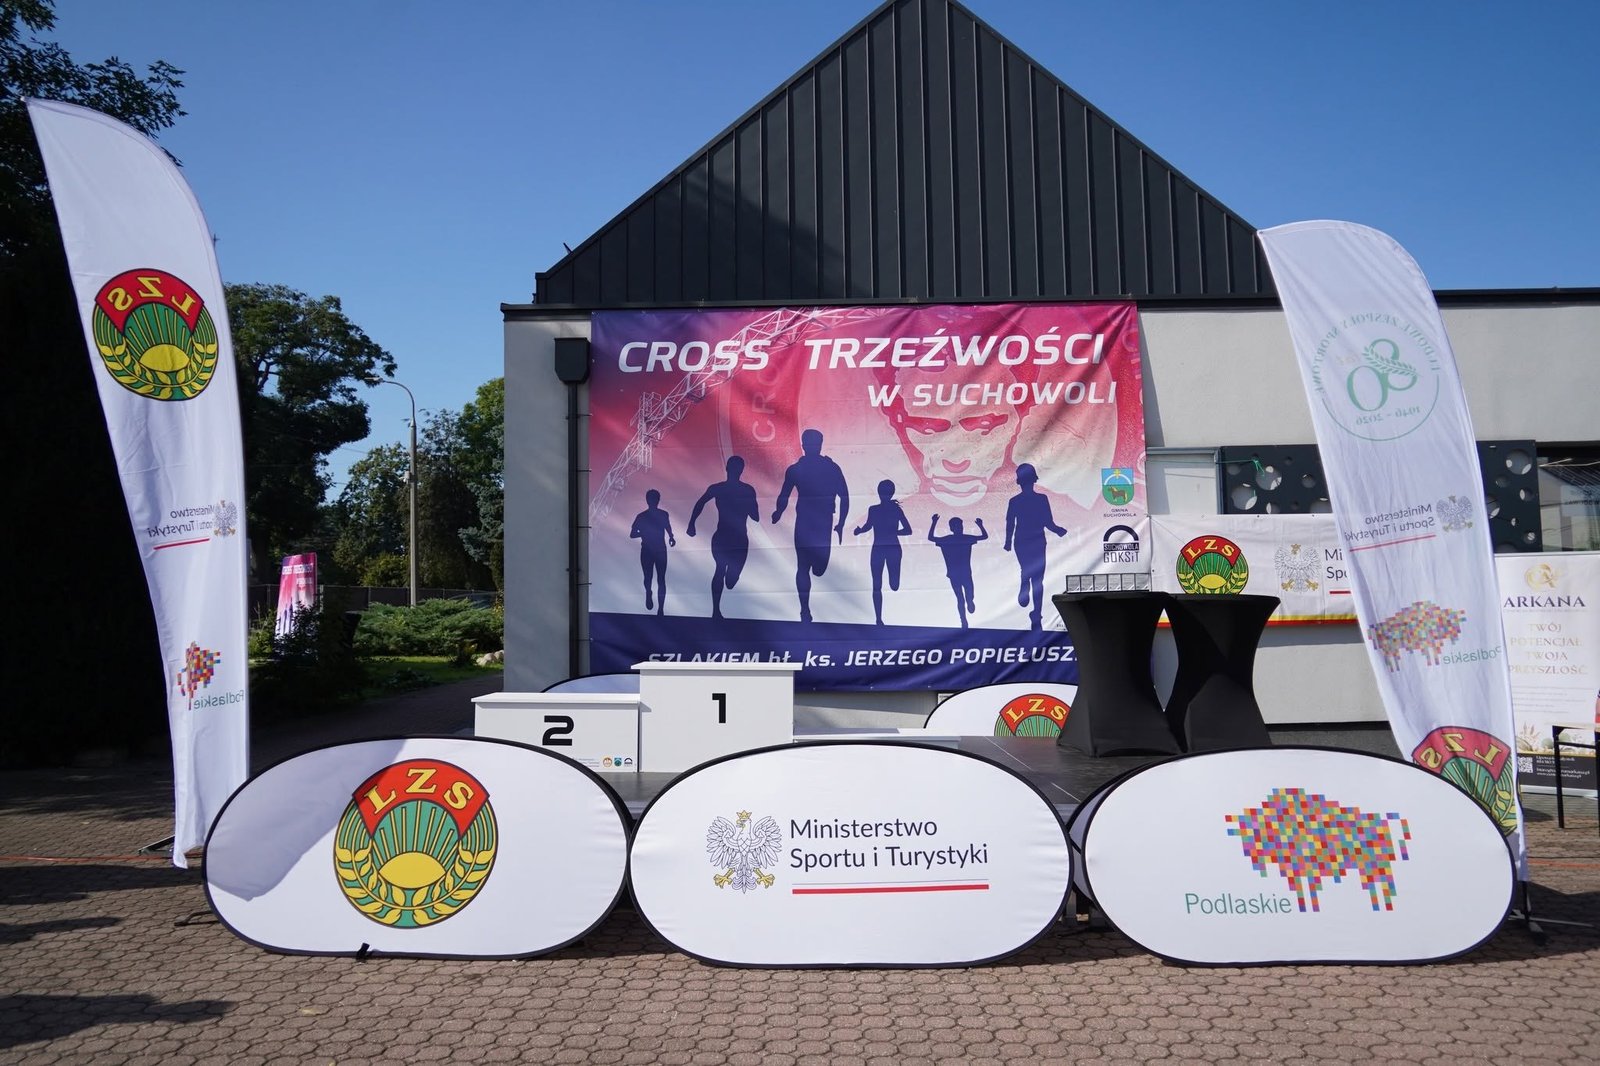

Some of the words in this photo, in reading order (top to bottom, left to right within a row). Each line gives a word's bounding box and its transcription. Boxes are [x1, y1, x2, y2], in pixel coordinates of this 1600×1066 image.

[618, 339, 772, 373] CROSS
[804, 326, 1105, 370] TRZEŹWOŚCI
[868, 384, 901, 407] W
[912, 381, 1117, 406] SUCHOWOLI
[1186, 539, 1235, 558] LZS
[1504, 596, 1586, 608] ARKANA
[804, 650, 836, 667] ks.
[845, 649, 943, 667] JERZEGO
[950, 646, 1078, 664] POPIEŁUSZ
[1526, 651, 1568, 661] TWOJA
[712, 693, 726, 724] 1
[1006, 698, 1067, 722] LZS
[541, 715, 575, 746] 2
[364, 768, 475, 815] LZS
[790, 818, 938, 839] Ministerstwo
[790, 848, 865, 872] Sportu
[872, 847, 879, 867] i
[885, 843, 989, 870] Turystyki
[1185, 893, 1293, 915] Podlaskie
